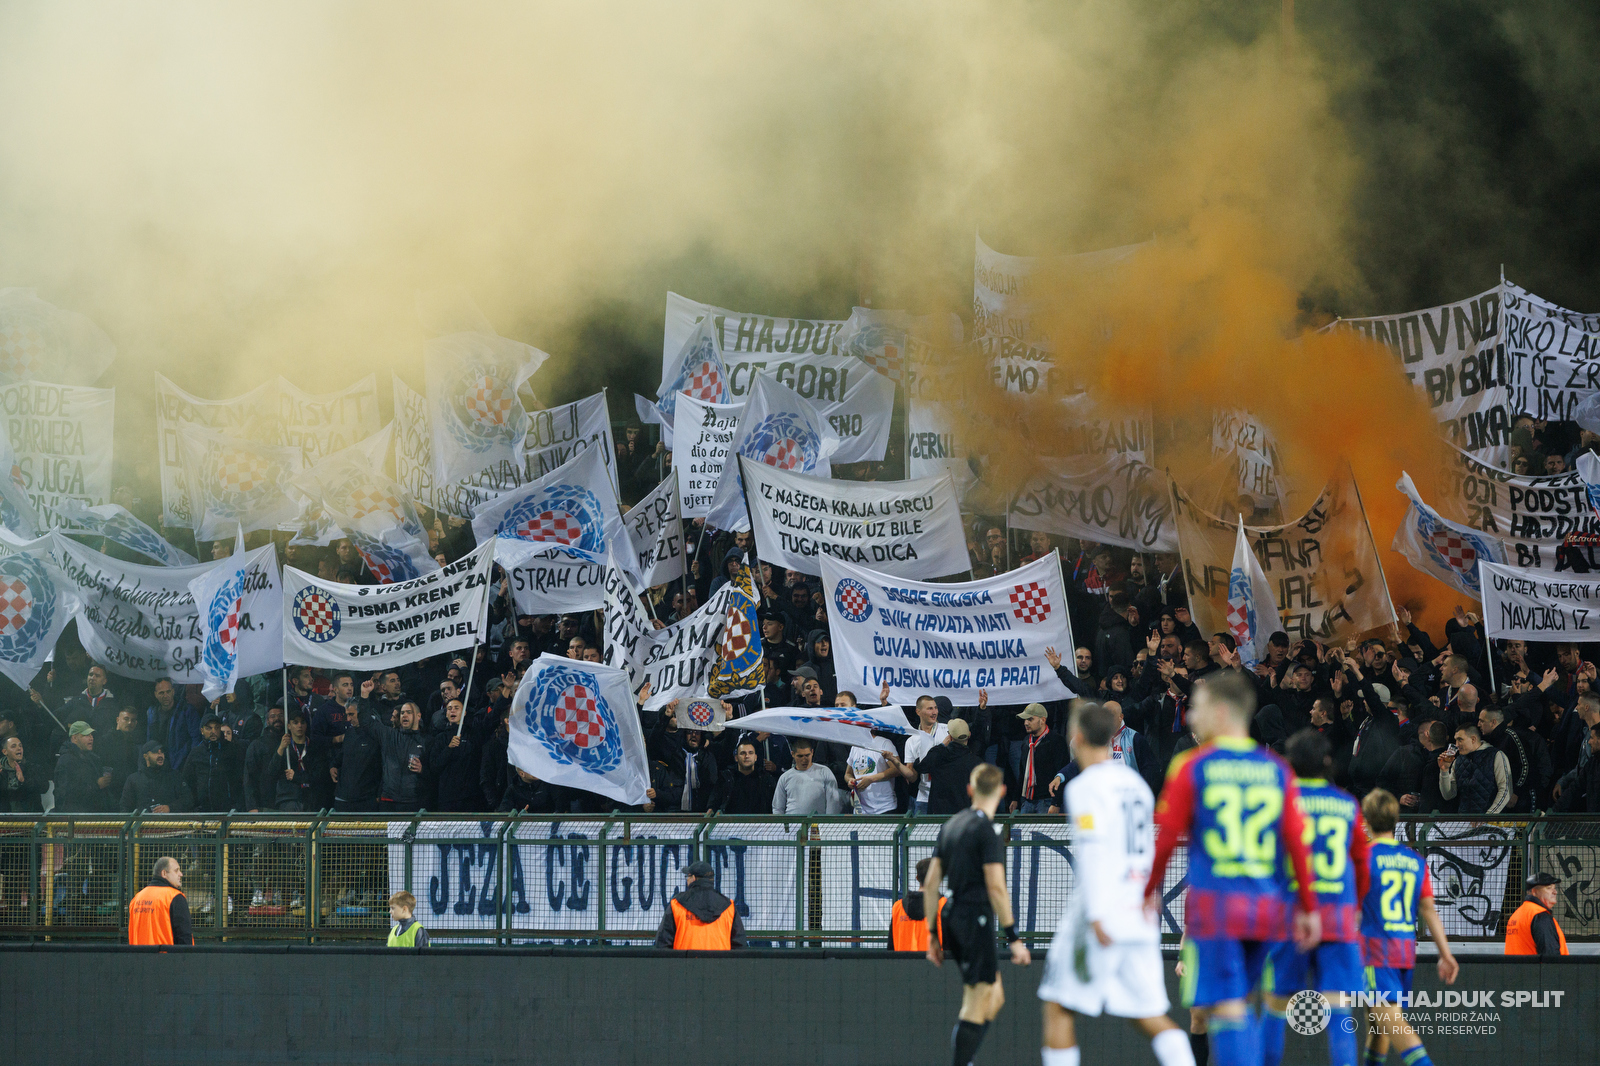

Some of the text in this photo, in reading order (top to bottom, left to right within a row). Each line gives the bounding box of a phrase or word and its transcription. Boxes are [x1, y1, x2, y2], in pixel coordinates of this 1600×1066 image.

[775, 361, 849, 403] GORI
[691, 445, 707, 458] dio
[697, 431, 711, 446] je
[37, 457, 85, 495] JUGA
[689, 480, 703, 489] ne
[761, 482, 934, 517] IZ NAŠEGA KRAJA U SRCU
[772, 508, 924, 539] POLJICA UVIK UZ BILE
[778, 531, 918, 564] TUGARSKA DICA
[347, 601, 401, 618] PISMA
[464, 573, 488, 590] ZA
[513, 567, 571, 594] STRAH
[1493, 574, 1539, 599] UVIJEK
[1544, 582, 1590, 602] VJERNI
[881, 586, 993, 608] GOSPE SINJSKA
[376, 602, 461, 634] ŠAMPIONE
[878, 607, 1012, 633] SVIH HRVATA MATI
[1500, 601, 1590, 631] NAVIJAČI IZ
[349, 621, 478, 658] SPLITSKE BIJEL
[873, 630, 1028, 660] ČUVAJ NAM HAJDUKA
[863, 665, 1041, 689] I VOJSKU KOJA GA PRATI
[1202, 782, 1284, 861] 32
[1379, 869, 1417, 922] 21
